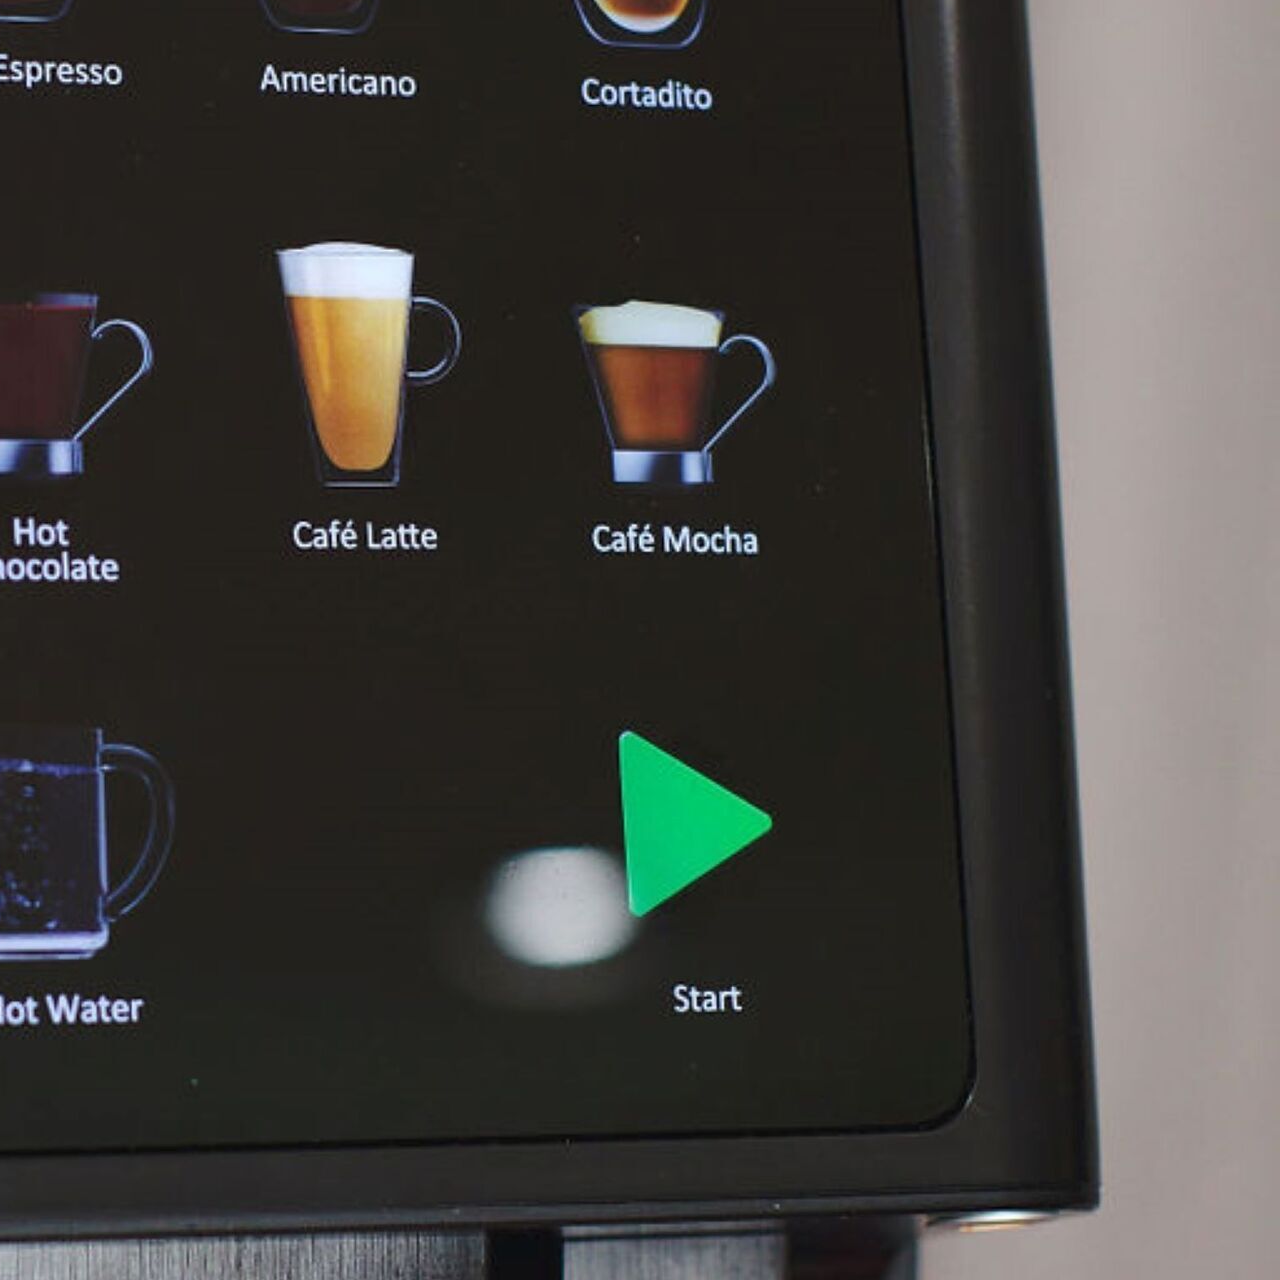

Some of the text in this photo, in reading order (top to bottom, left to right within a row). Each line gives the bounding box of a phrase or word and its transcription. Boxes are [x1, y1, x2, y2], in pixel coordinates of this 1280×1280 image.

[260, 63, 417, 98] Americano
[580, 77, 713, 111] Cortadito
[13, 517, 70, 547] Hot
[293, 519, 438, 550] Café Latte
[591, 523, 759, 555] Café Mocha
[45, 993, 145, 1025] Water
[673, 984, 743, 1013] Start
